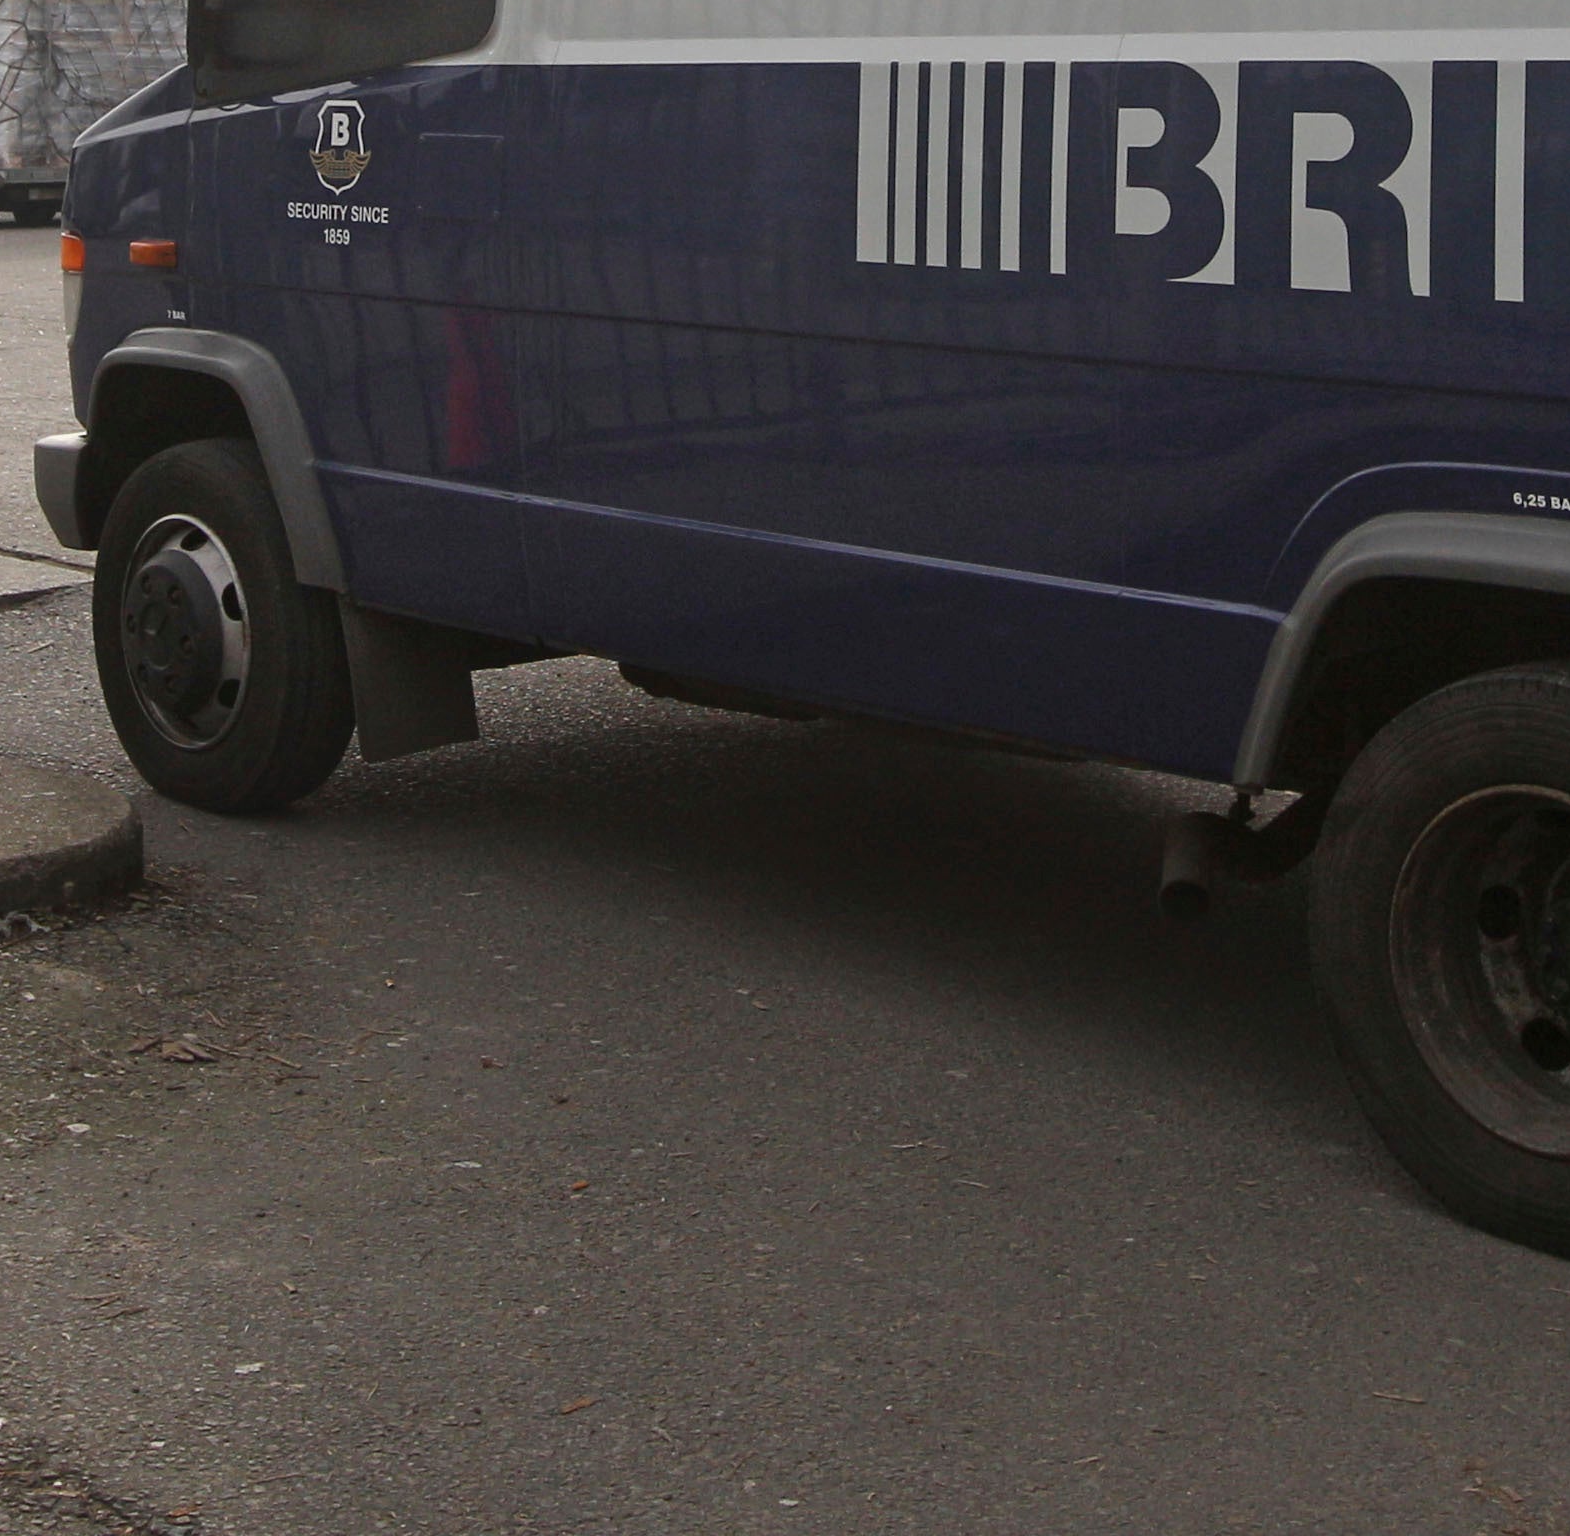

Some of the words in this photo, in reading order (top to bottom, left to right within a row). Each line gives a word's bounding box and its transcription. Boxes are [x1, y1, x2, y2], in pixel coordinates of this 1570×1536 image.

[330, 113, 350, 146] B
[287, 202, 348, 222] SECURITY
[351, 206, 389, 224] SINCE
[323, 228, 351, 245] 1859
[1513, 492, 1547, 508] 6,25
